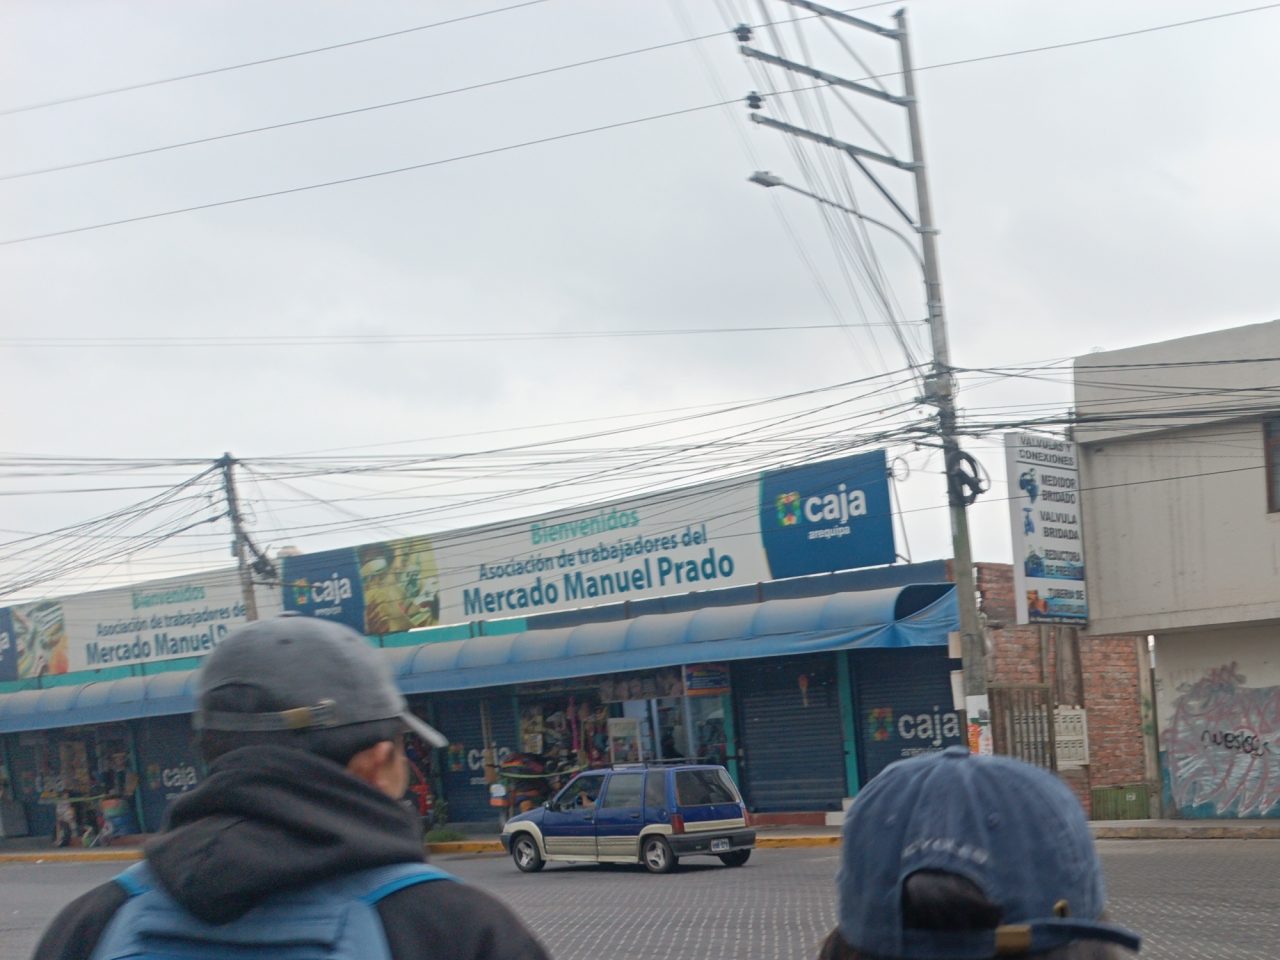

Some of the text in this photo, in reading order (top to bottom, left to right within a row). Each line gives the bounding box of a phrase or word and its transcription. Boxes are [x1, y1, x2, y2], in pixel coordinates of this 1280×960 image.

[1019, 449, 1074, 466] CONEXIONES
[1041, 474, 1076, 489] MEDIDOR
[804, 483, 867, 524] caja
[1042, 489, 1076, 505] BRIDADO
[529, 507, 641, 546] Bienvenidos
[1040, 510, 1077, 525] VALVULA
[808, 524, 851, 540] arequipa
[1043, 526, 1080, 540] BRIDADA
[479, 524, 708, 582] Asociación de trabajadores del
[311, 571, 352, 604] caja
[463, 547, 735, 616] Mercado Manuel Prado
[131, 584, 206, 611] Bienvenidos
[96, 616, 149, 637] Asociación
[150, 617, 163, 631] de
[86, 634, 151, 666] Mercado
[154, 628, 216, 657] Manuel
[897, 705, 960, 747] caja
[162, 761, 197, 791] caja
